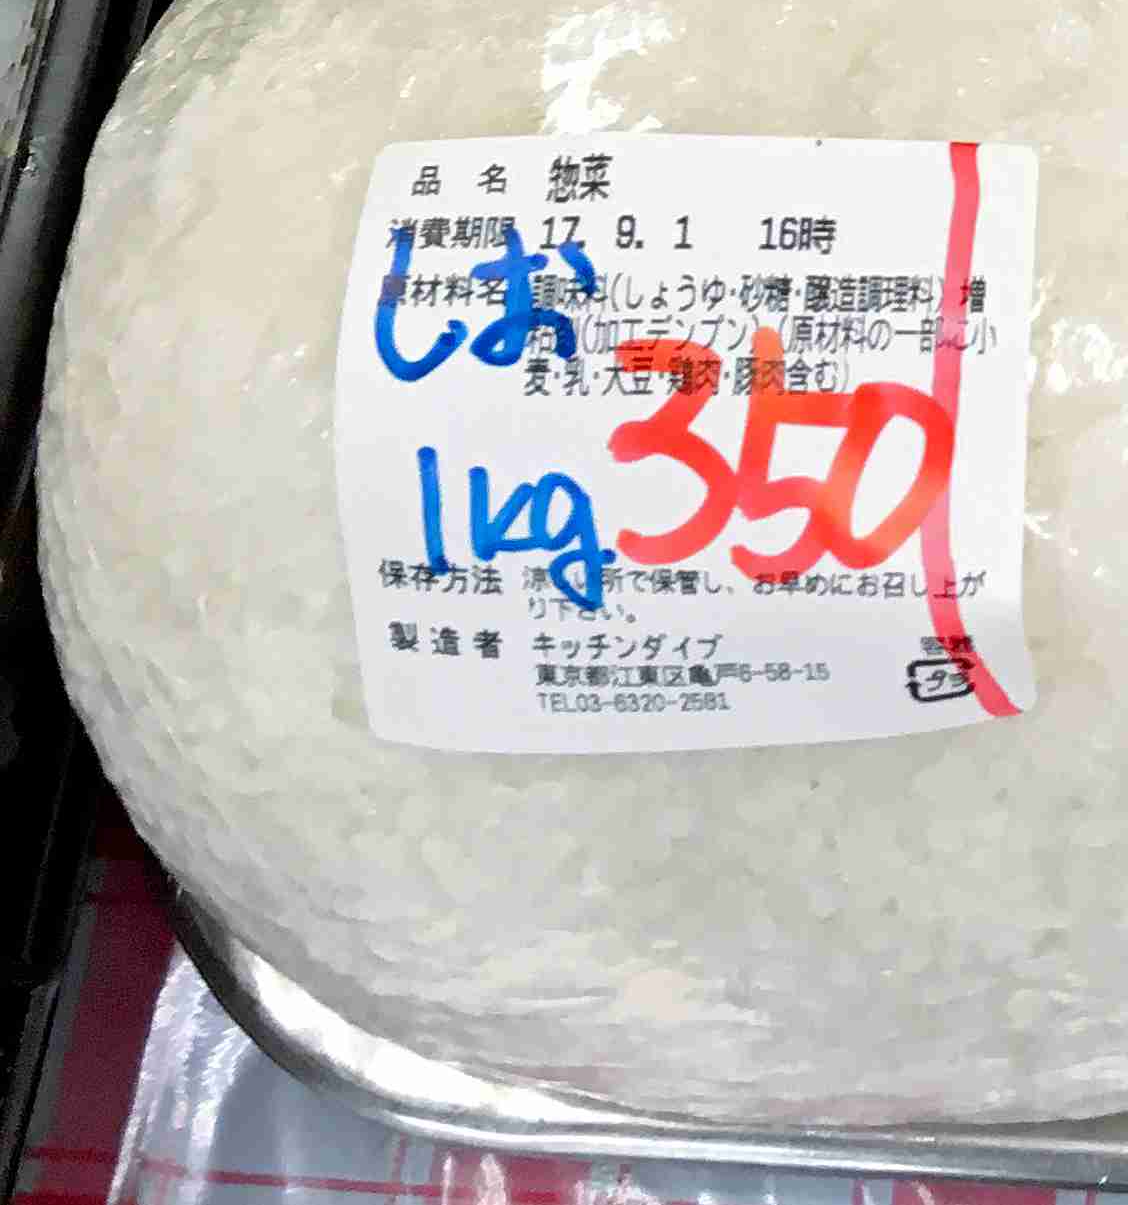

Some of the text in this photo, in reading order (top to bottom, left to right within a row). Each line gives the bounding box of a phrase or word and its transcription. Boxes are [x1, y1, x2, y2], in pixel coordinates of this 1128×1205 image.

[546, 153, 613, 203] 惣菜
[386, 216, 516, 249] 消費期限
[674, 215, 693, 249] 1
[758, 216, 837, 255] 16時
[375, 223, 598, 382] しお
[608, 327, 954, 582] 350
[378, 559, 503, 595] 保存方法
[531, 632, 723, 660] キッチンダイブ
